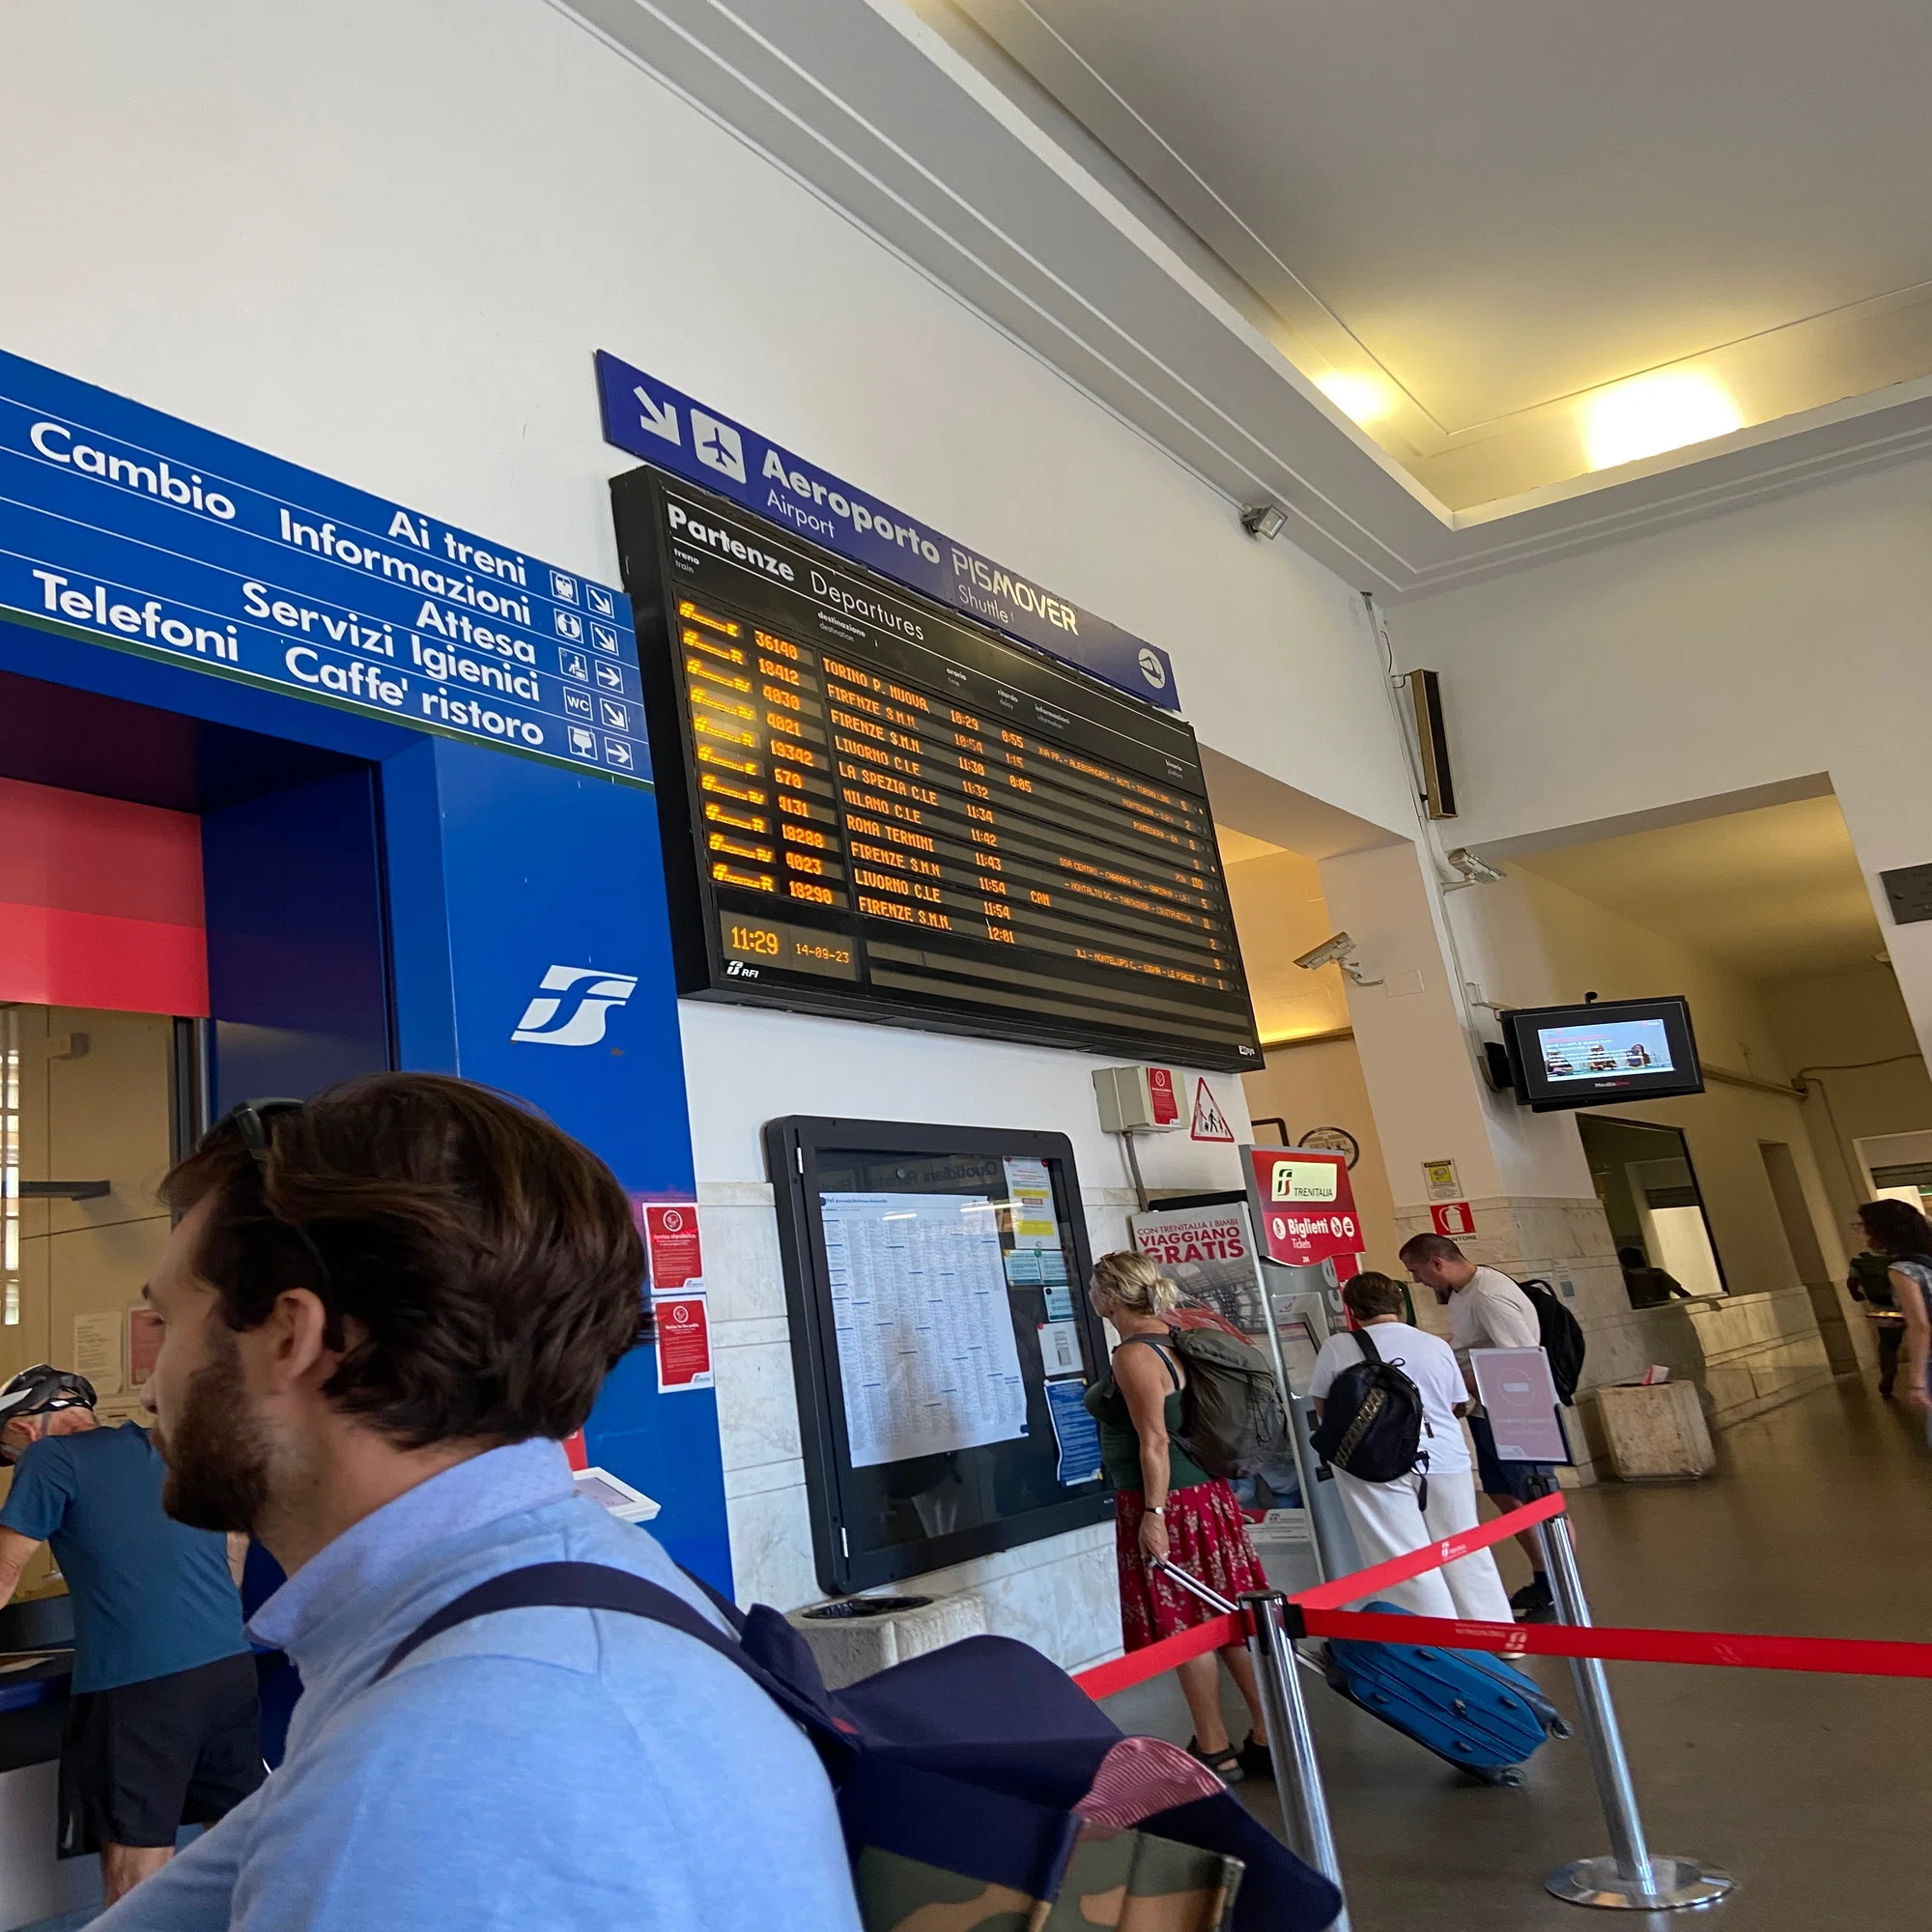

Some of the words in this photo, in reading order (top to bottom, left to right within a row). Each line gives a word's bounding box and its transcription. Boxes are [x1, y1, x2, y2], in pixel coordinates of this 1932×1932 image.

[31, 422, 236, 520] Cambio
[762, 450, 941, 564] Aeroporto
[280, 509, 530, 626] Informazioni
[388, 512, 429, 552] Ai
[444, 532, 526, 586] treni
[668, 503, 794, 582] Partenze
[810, 570, 924, 640] Departures
[674, 548, 699, 565] treno
[675, 561, 695, 574] train
[767, 489, 835, 538] Airport
[958, 584, 1009, 624] Shuttle
[33, 570, 239, 662] Telefoni
[243, 582, 394, 657] Servizi
[412, 635, 540, 702] Igienici
[416, 602, 536, 665] Attesa
[817, 611, 866, 638] destinazione
[819, 622, 855, 642] destination
[285, 646, 408, 707] Caffe'
[422, 689, 544, 745] ristoro
[568, 696, 590, 712] WC
[753, 629, 799, 662] 36140
[822, 657, 867, 689] TORINO
[871, 676, 885, 696] P.
[949, 707, 980, 732] 10:29
[1000, 727, 1024, 750] 0:55
[946, 668, 967, 681] orario
[998, 689, 1018, 703] ritardo
[757, 655, 800, 687] 18412
[826, 682, 881, 717] FIRENZE
[952, 730, 983, 754] 10:54
[1004, 750, 1024, 770] 1:15
[760, 682, 801, 712] 4030
[829, 708, 885, 742] FIRENZE
[956, 754, 985, 777] 11:30
[1008, 773, 1033, 794] 0:05
[765, 710, 802, 737] 4021
[893, 754, 921, 777] C.LE
[960, 778, 989, 800] 11:32
[769, 737, 813, 767] 19342
[838, 760, 857, 781] LA
[861, 768, 907, 797] SPEZIA
[910, 784, 938, 807] C.LE
[965, 802, 994, 824] 11:34
[842, 787, 890, 815] MILANO
[894, 803, 922, 825] C.LE
[969, 827, 998, 847] 11:42
[1200, 896, 1208, 910] 5
[845, 813, 881, 838] ROMA
[884, 825, 934, 853] TERMINI
[974, 850, 1002, 871] 11:43
[781, 822, 824, 849] 18288
[849, 840, 905, 869] FIRENZE
[978, 875, 1007, 895] 11:54
[1208, 937, 1217, 951] 2
[783, 850, 822, 875] 4023
[913, 883, 942, 903] C.LE
[982, 899, 1010, 920] 11:54
[787, 878, 833, 905] 18290
[858, 895, 914, 923] FIRENZE
[986, 924, 1015, 945] 12:01
[731, 926, 779, 955] 11:29
[795, 944, 850, 964] 14-09-23
[741, 968, 759, 979] RFI
[1294, 1187, 1333, 1197] TRENITALIA
[1137, 1227, 1157, 1236] CON
[1159, 1222, 1208, 1233] TRENITALIA
[1214, 1218, 1238, 1227] BIMBI
[1139, 1226, 1239, 1247] VIAGGIANO
[1287, 1217, 1329, 1238] Biglietti
[1291, 1237, 1312, 1249] Tickets
